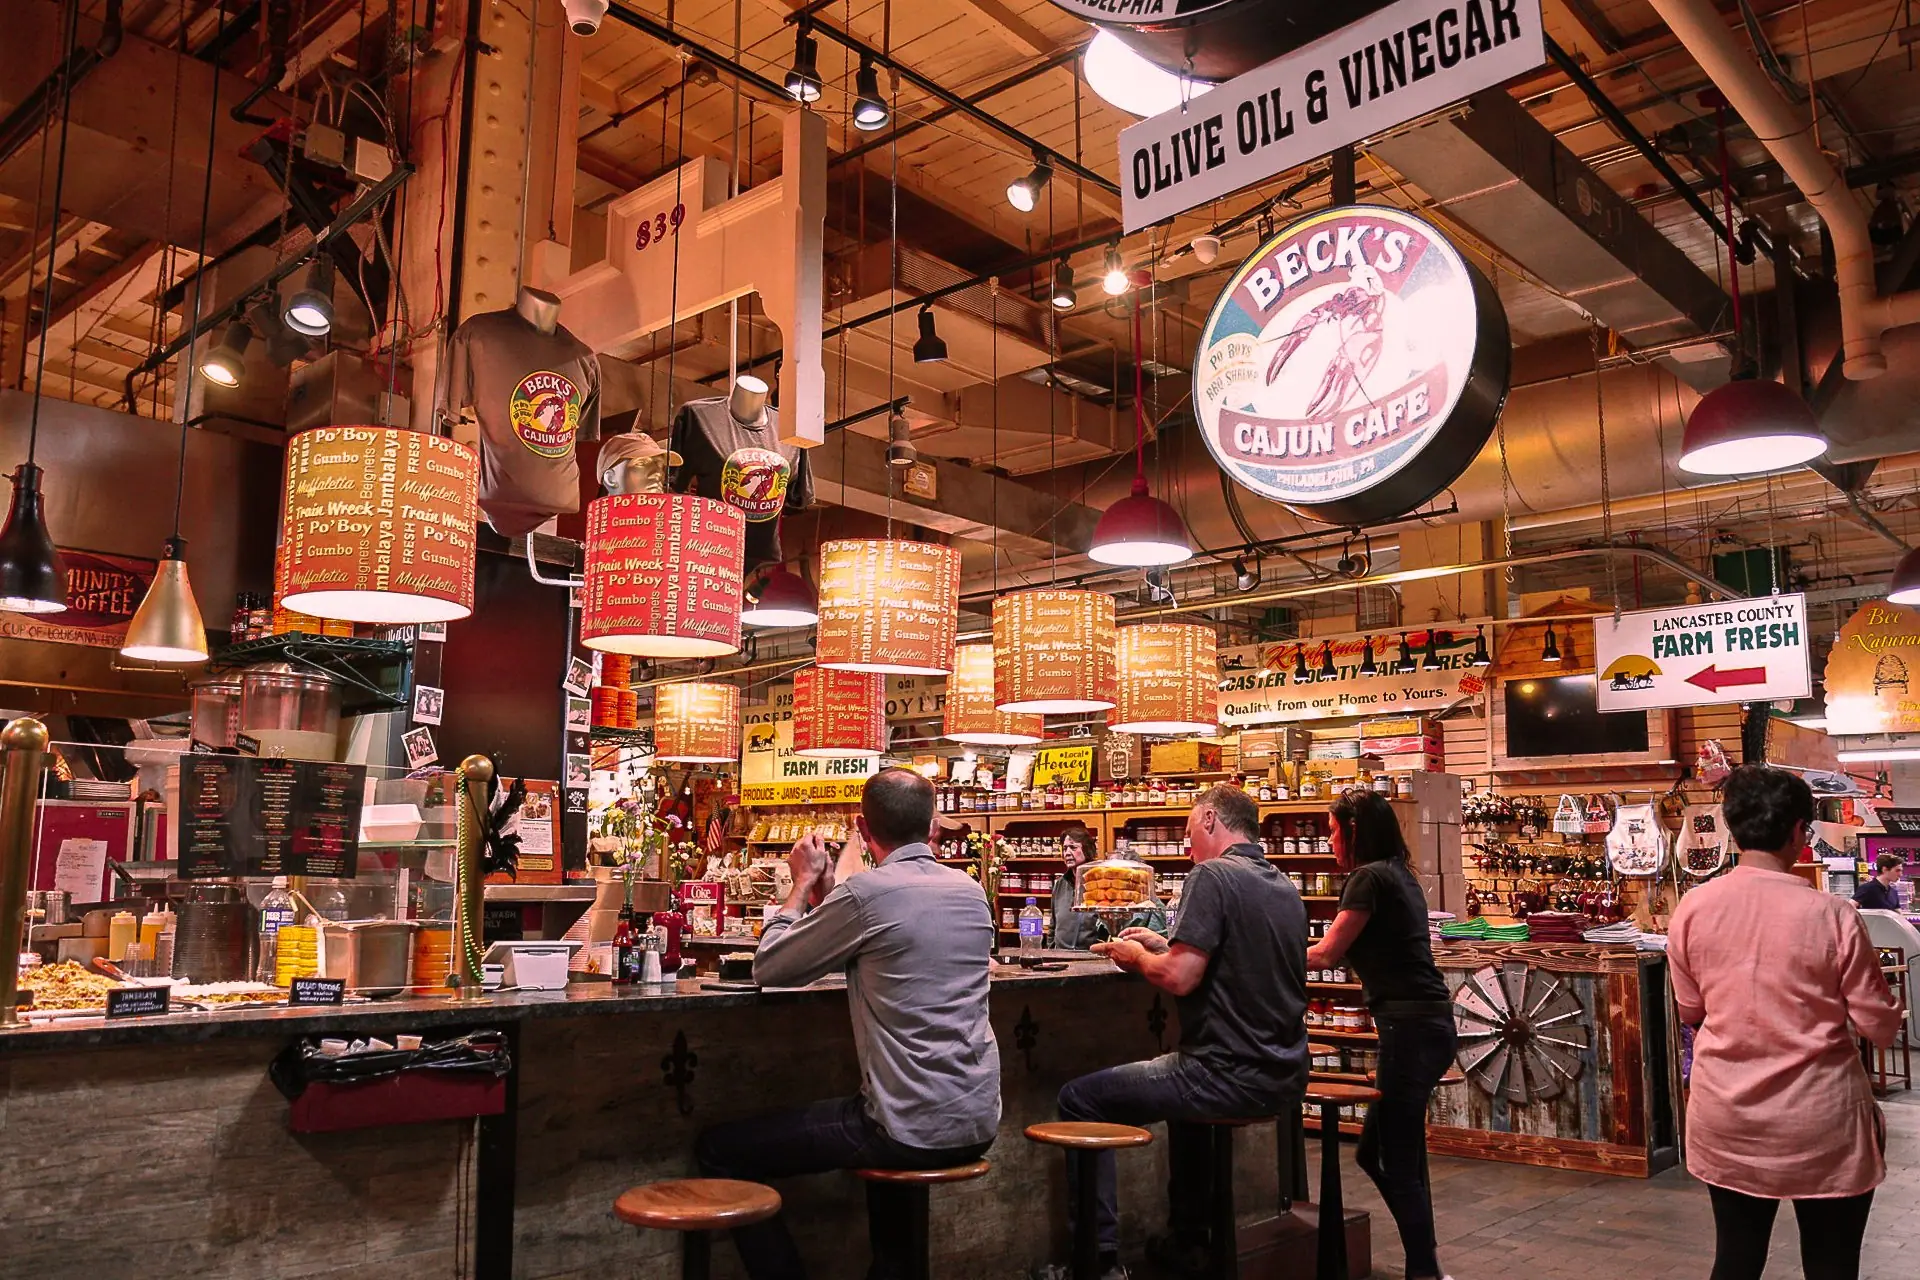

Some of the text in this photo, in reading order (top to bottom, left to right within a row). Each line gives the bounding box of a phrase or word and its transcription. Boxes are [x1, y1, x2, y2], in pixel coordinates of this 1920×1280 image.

[1133, 0, 1522, 201] OLIVE OIL & VINEGAR
[636, 204, 685, 250] 839
[1244, 225, 1414, 313] BECK'S
[525, 376, 571, 396] BECK'S
[1232, 381, 1432, 459] CAJUN CAFE
[524, 429, 572, 443] CAJUN CAFE
[313, 452, 360, 466] Gumbo
[408, 432, 420, 474] FRESH
[360, 448, 376, 499] Beignets
[378, 430, 401, 518] Jambalaya
[426, 460, 465, 480] Gumbo
[296, 477, 356, 498] Muffaletta
[400, 479, 461, 505] Muffaletta
[296, 501, 375, 520] Train Wreck
[729, 495, 756, 510] CAJUN
[400, 505, 471, 535] Train Wreck
[600, 498, 609, 533] FRESH
[612, 515, 651, 526] Gumbo
[691, 497, 701, 533] FRESH
[652, 511, 665, 556] Beignets
[666, 496, 685, 572] Jambalaya
[706, 522, 736, 537] Gumbo
[307, 545, 353, 557] Gumbo
[402, 523, 416, 564] FRESH
[685, 539, 734, 558] Muffaletta
[421, 550, 461, 569] Gumbo
[624, 558, 664, 571] Wreck
[899, 560, 934, 572] Gumbo
[291, 571, 349, 590] Muffaletta
[685, 561, 742, 584] Train Wreck
[395, 572, 457, 594] Muffaletta
[596, 575, 604, 611] FRESH
[67, 588, 134, 615] COFFEE
[607, 594, 646, 605] Gumbo
[687, 576, 698, 612] FRESH
[702, 600, 733, 614] Gumbo
[879, 597, 941, 613] Train Wreck
[1037, 608, 1072, 616] Gumbo
[880, 609, 891, 642] FRESH
[1012, 595, 1021, 652] Jambalaya
[1653, 605, 1795, 632] LANCASTER COUNTY
[1867, 607, 1903, 624] Bee
[3, 622, 24, 636] CUP
[28, 626, 42, 637] OF
[48, 627, 97, 644] LOUISIANA
[681, 618, 730, 637] Muffaletta
[895, 629, 930, 641] Gumbo
[1052, 641, 1083, 651] Wreck
[1652, 623, 1799, 659] FARM FRESH
[875, 648, 928, 663] Muffaletta
[1038, 669, 1072, 677] Gumbo
[848, 704, 869, 712] Wreck
[1277, 700, 1307, 712] from
[1312, 697, 1334, 709] our
[1339, 693, 1378, 705] Home
[1383, 692, 1397, 702] to
[1402, 687, 1448, 700] Yours.
[1064, 750, 1084, 758] Local
[783, 759, 868, 776] FARM FRESH
[1036, 752, 1087, 781] Honey
[743, 788, 775, 800] PRODUCE
[781, 787, 800, 800] JAMS
[808, 785, 836, 799] JELLIES
[691, 884, 711, 898] Coke
